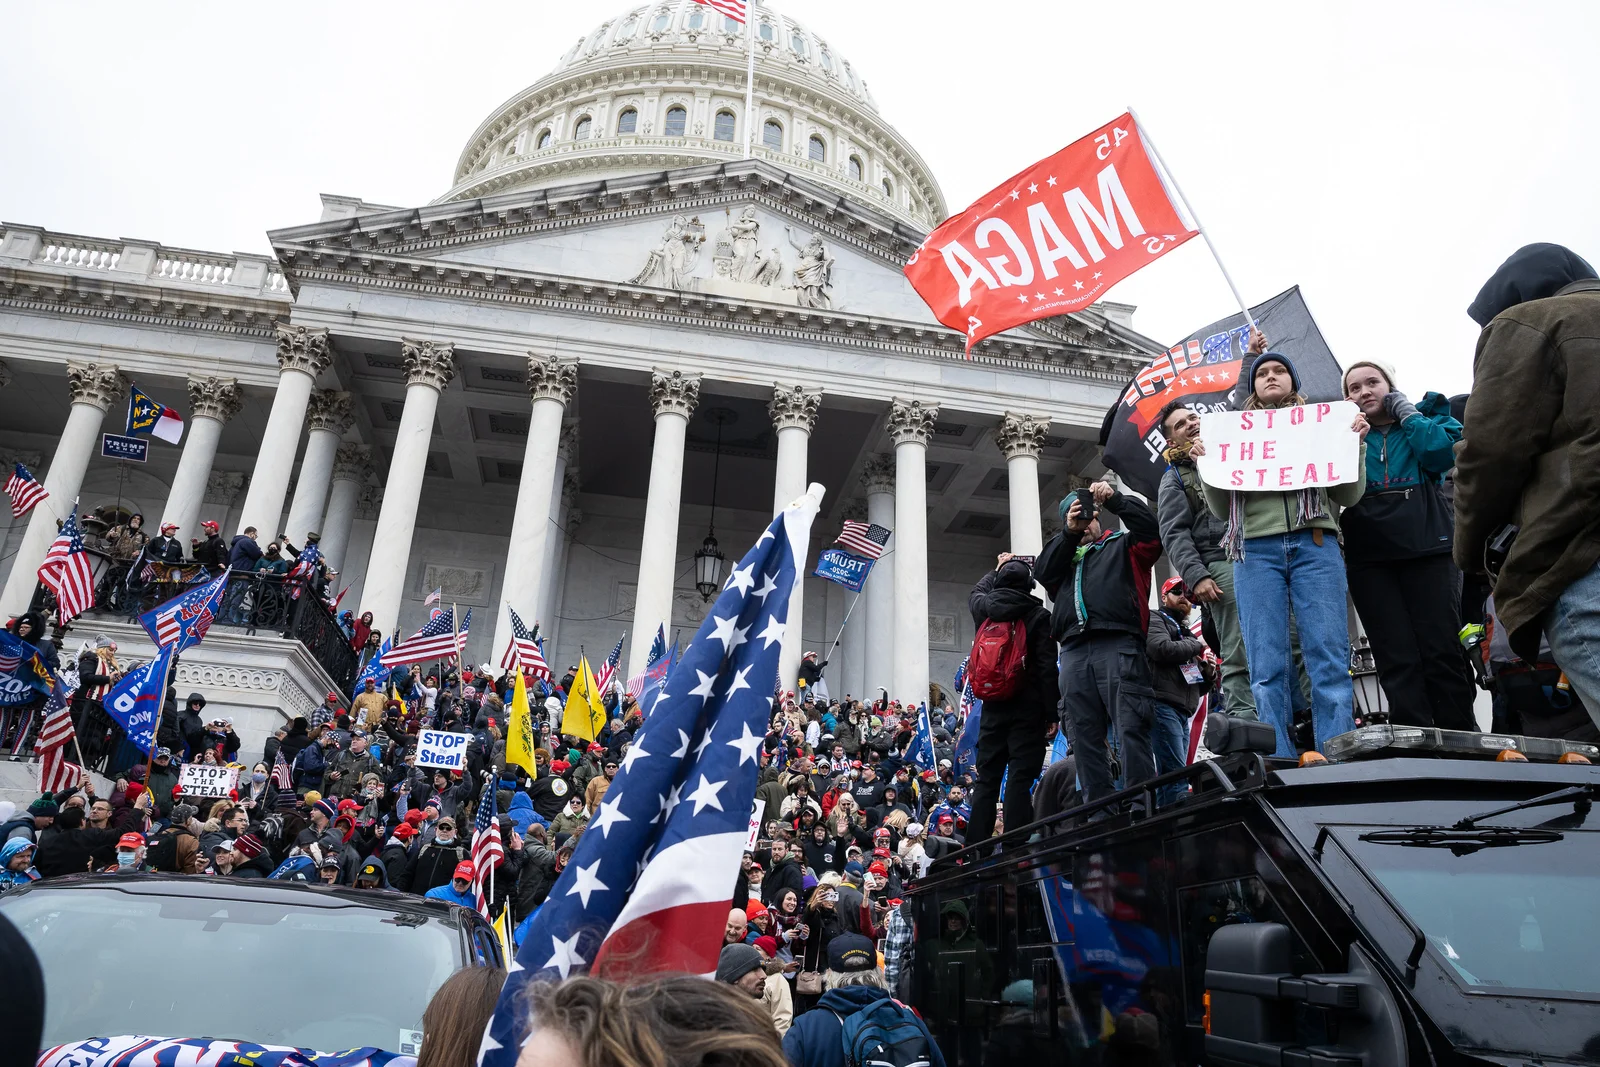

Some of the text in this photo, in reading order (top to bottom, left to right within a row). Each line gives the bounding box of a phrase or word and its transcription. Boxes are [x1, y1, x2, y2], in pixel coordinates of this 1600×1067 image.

[1240, 403, 1331, 431] STOP
[105, 439, 145, 450] TRUMP
[108, 445, 141, 454] PENCE
[1219, 440, 1277, 462] THE
[1230, 462, 1341, 488] STEAL
[423, 732, 465, 748] STOP
[420, 749, 461, 766] Steal
[187, 767, 227, 779] STOP
[193, 777, 215, 786] THE
[182, 784, 228, 797] STEAL
